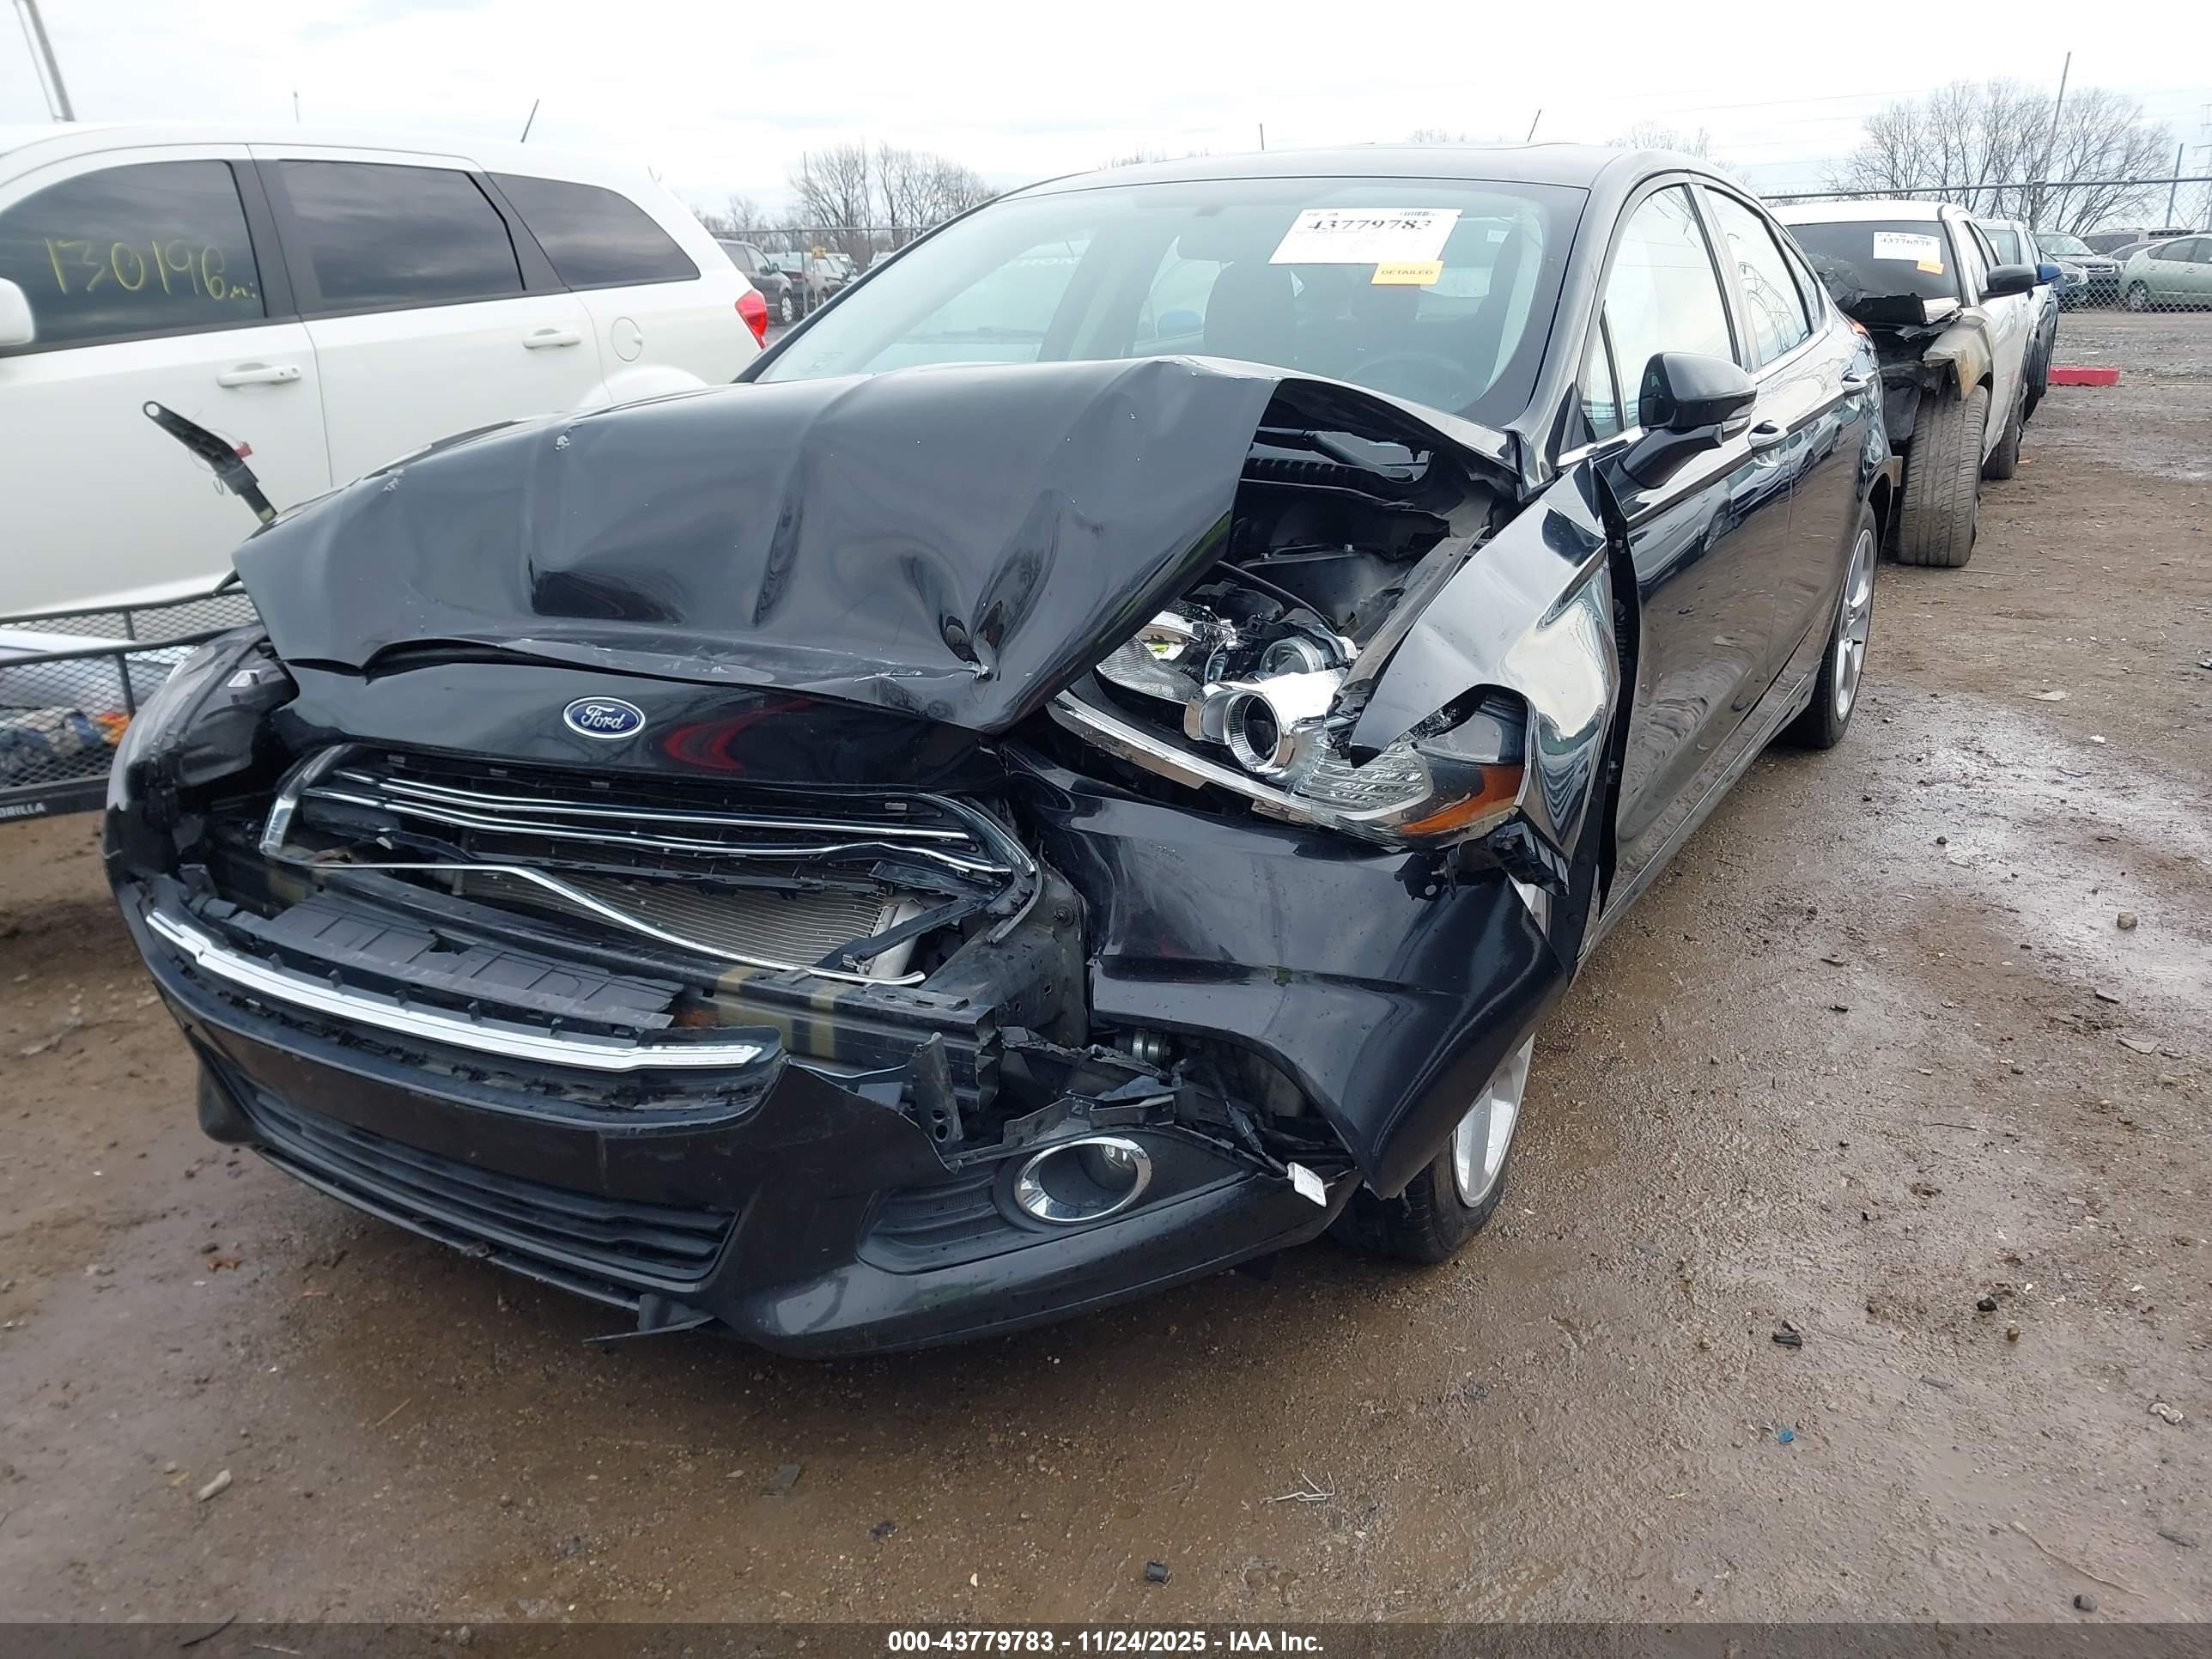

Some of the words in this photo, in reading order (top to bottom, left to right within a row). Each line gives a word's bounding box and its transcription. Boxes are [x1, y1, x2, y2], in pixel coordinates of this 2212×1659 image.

[1306, 219, 1432, 230] 43779783
[46, 239, 225, 300] 130196
[580, 705, 626, 729] Ford
